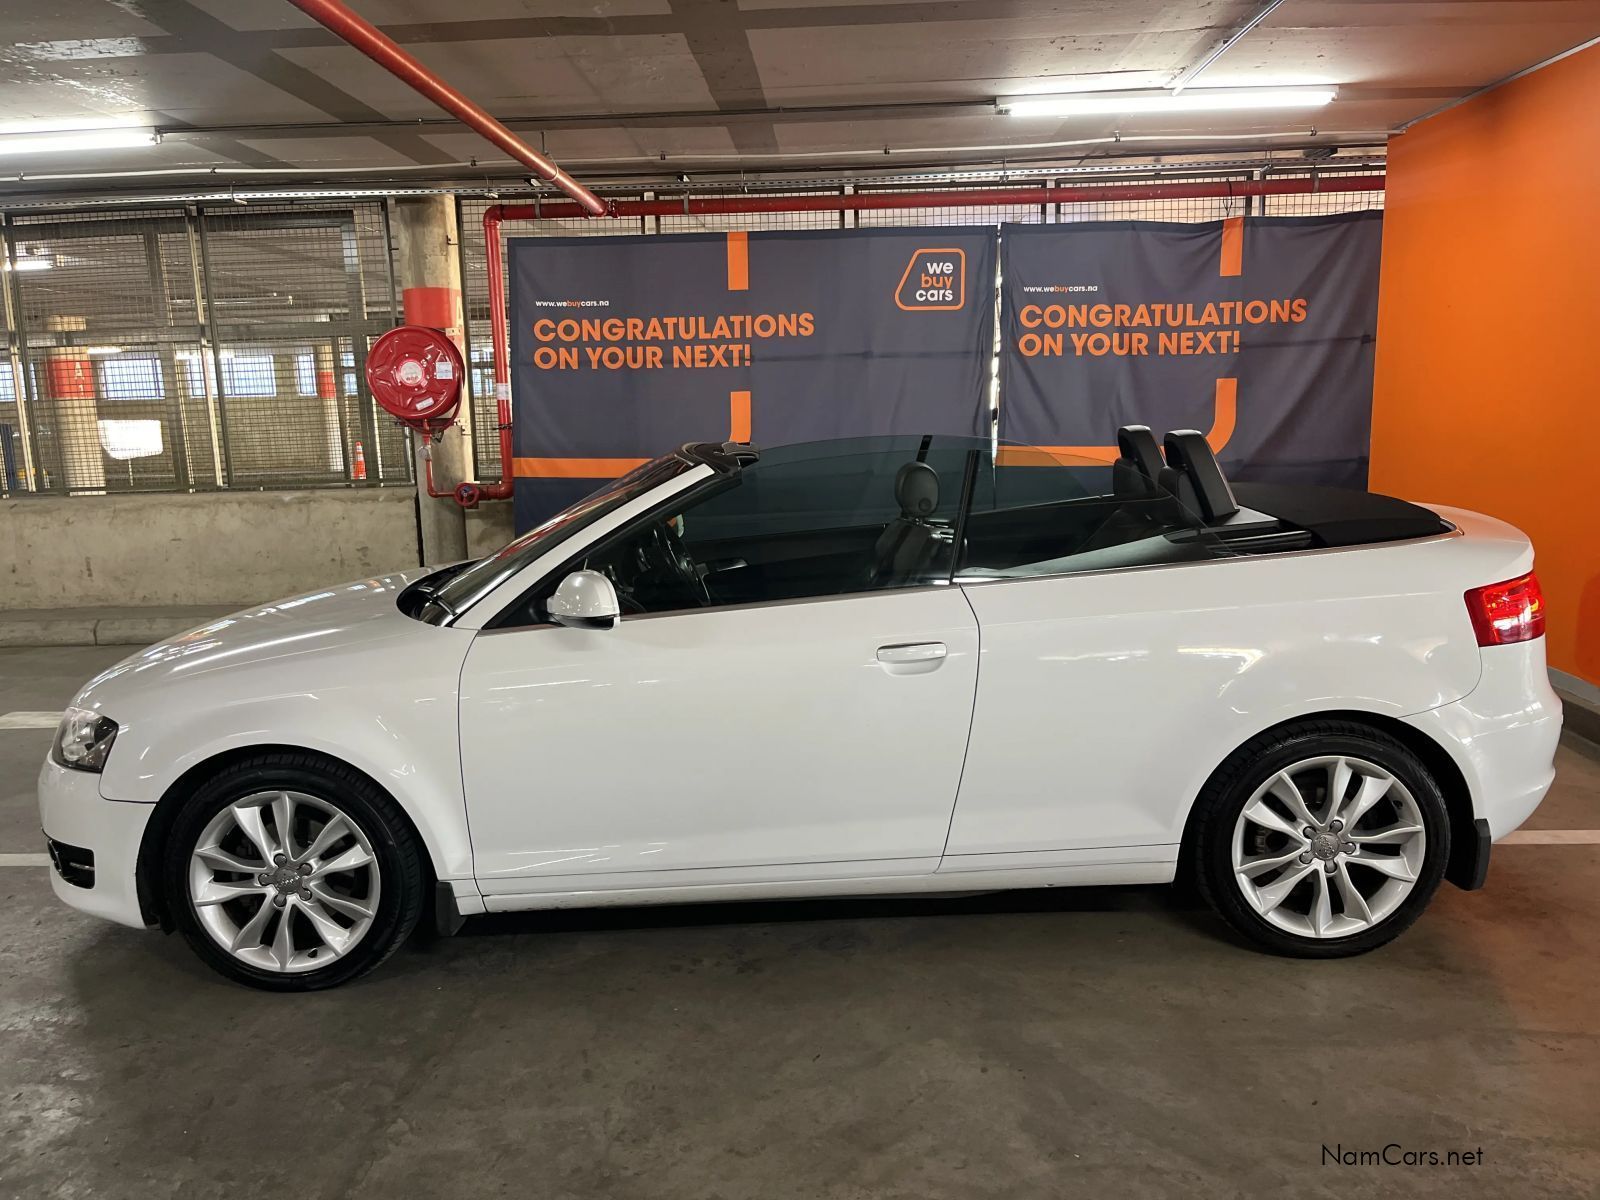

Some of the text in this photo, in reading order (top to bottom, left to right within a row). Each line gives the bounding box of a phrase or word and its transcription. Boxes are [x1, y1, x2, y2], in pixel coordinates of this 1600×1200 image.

[926, 262, 954, 275] we
[921, 273, 953, 290] buy
[1023, 285, 1098, 293] www.webuycars.na
[535, 299, 610, 308] www.webuycars.na
[915, 289, 954, 301] cars
[1019, 299, 1308, 329] CONGRATULATIONS
[533, 312, 815, 342] CONGRATULATIONS
[1019, 330, 1241, 357] ON YOUR NEXT!
[533, 343, 751, 370] ON YOUR NEXT!
